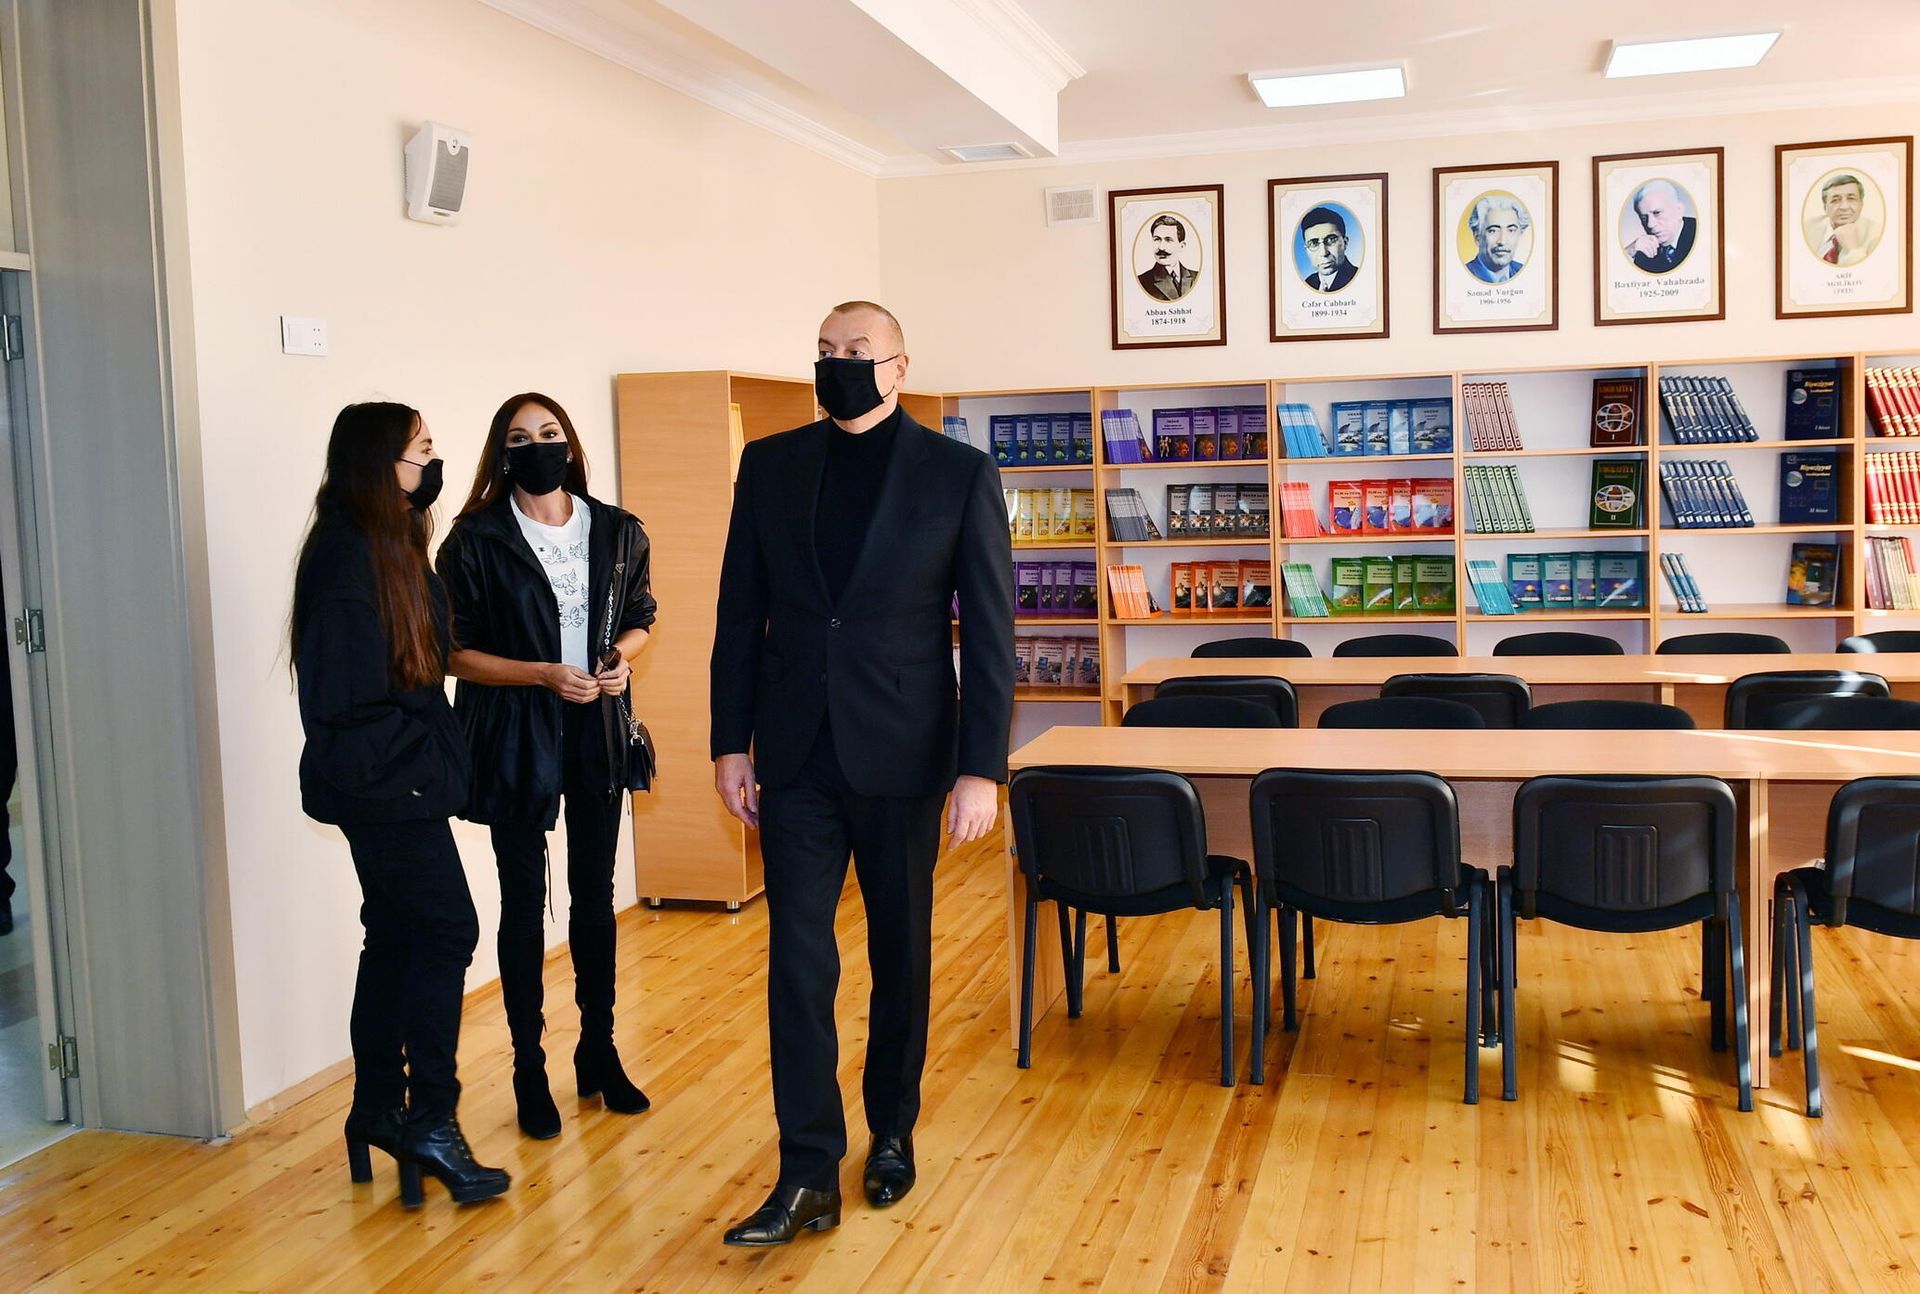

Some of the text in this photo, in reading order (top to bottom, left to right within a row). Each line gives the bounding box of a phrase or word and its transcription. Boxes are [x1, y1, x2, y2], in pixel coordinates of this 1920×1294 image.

[1639, 289, 1680, 298] 1925-2009
[1311, 309, 1348, 317] 1899-1934
[1151, 317, 1186, 325] 1874-1918
